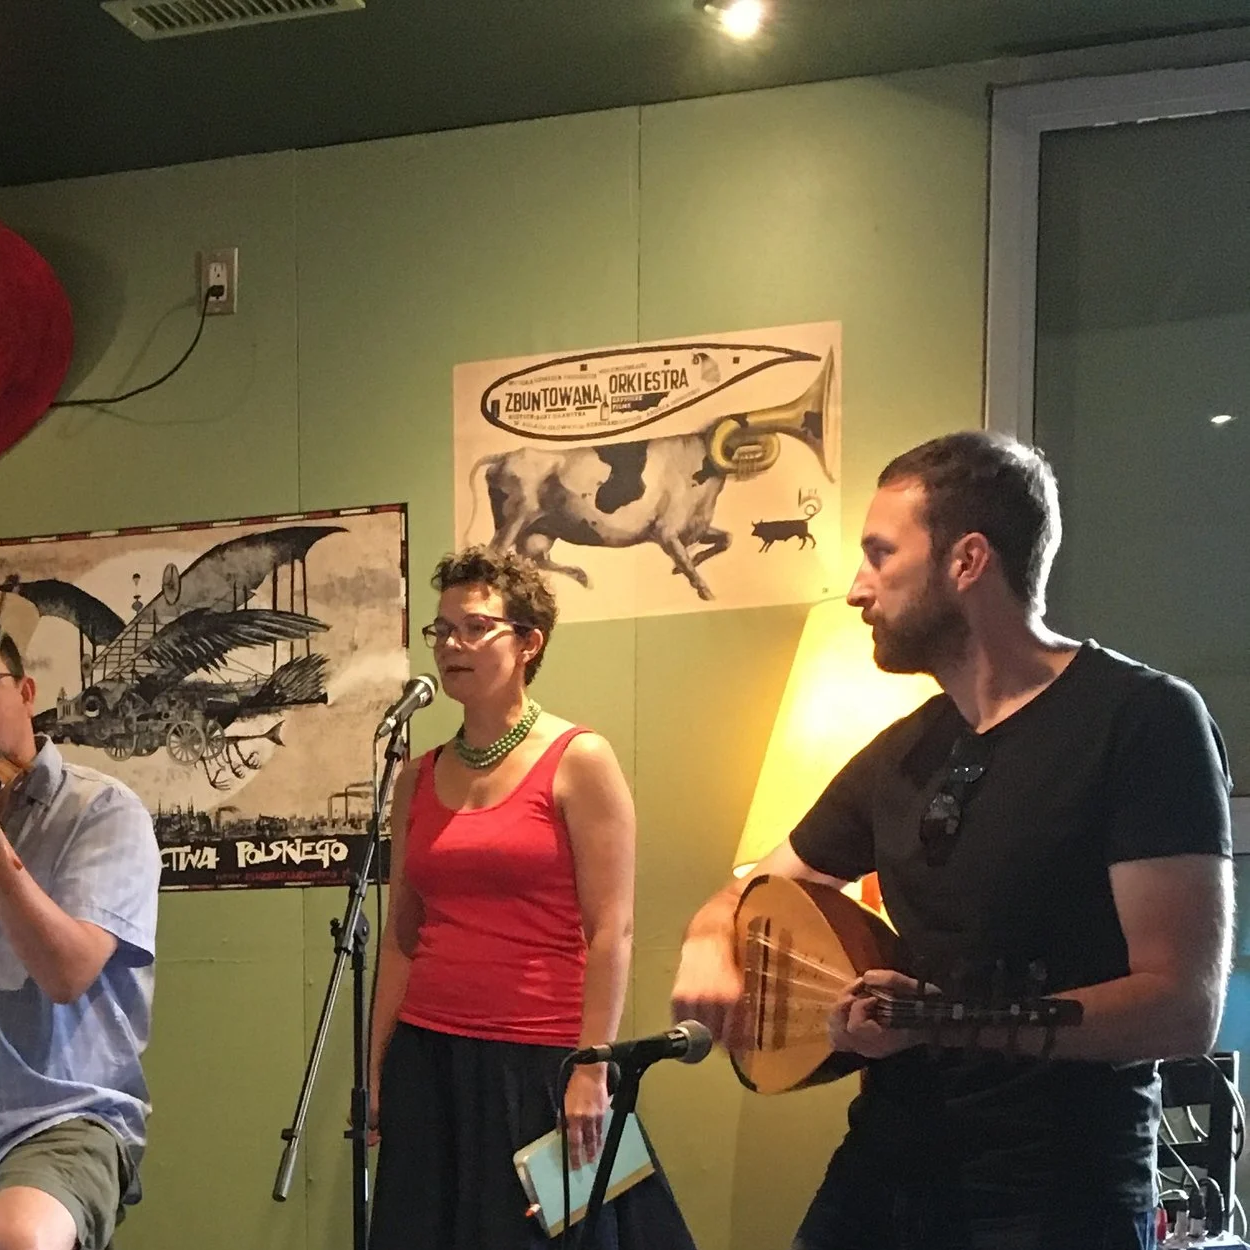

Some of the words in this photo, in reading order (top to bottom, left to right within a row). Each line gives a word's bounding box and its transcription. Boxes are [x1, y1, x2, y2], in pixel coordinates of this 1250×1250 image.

[505, 384, 602, 413] ZBUNTOWANA
[609, 367, 689, 394] ORKIESTRA
[235, 838, 349, 869] POLSKIEGO
